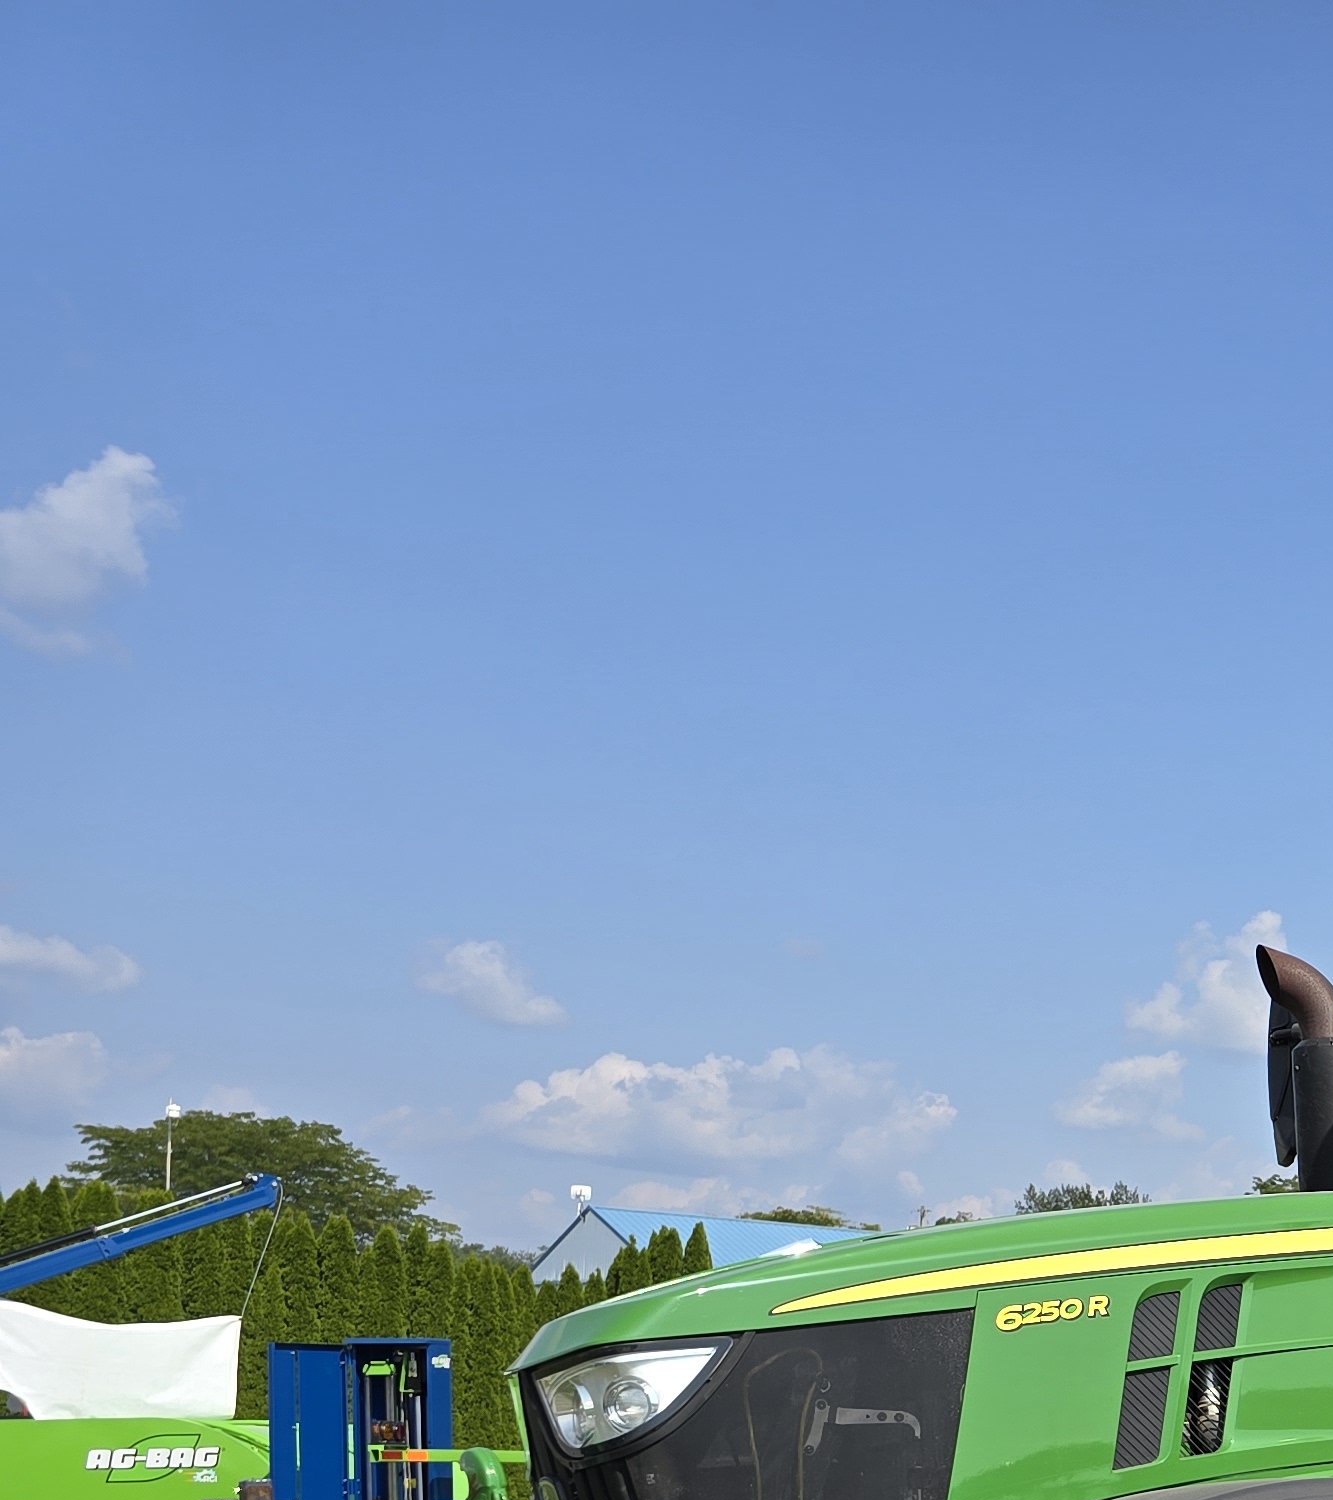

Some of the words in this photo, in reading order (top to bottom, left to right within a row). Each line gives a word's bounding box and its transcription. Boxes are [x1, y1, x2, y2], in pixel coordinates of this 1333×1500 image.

[995, 1297, 1084, 1332] 6250
[1087, 1294, 1110, 1318] R
[85, 1446, 221, 1470] AG-BAG
